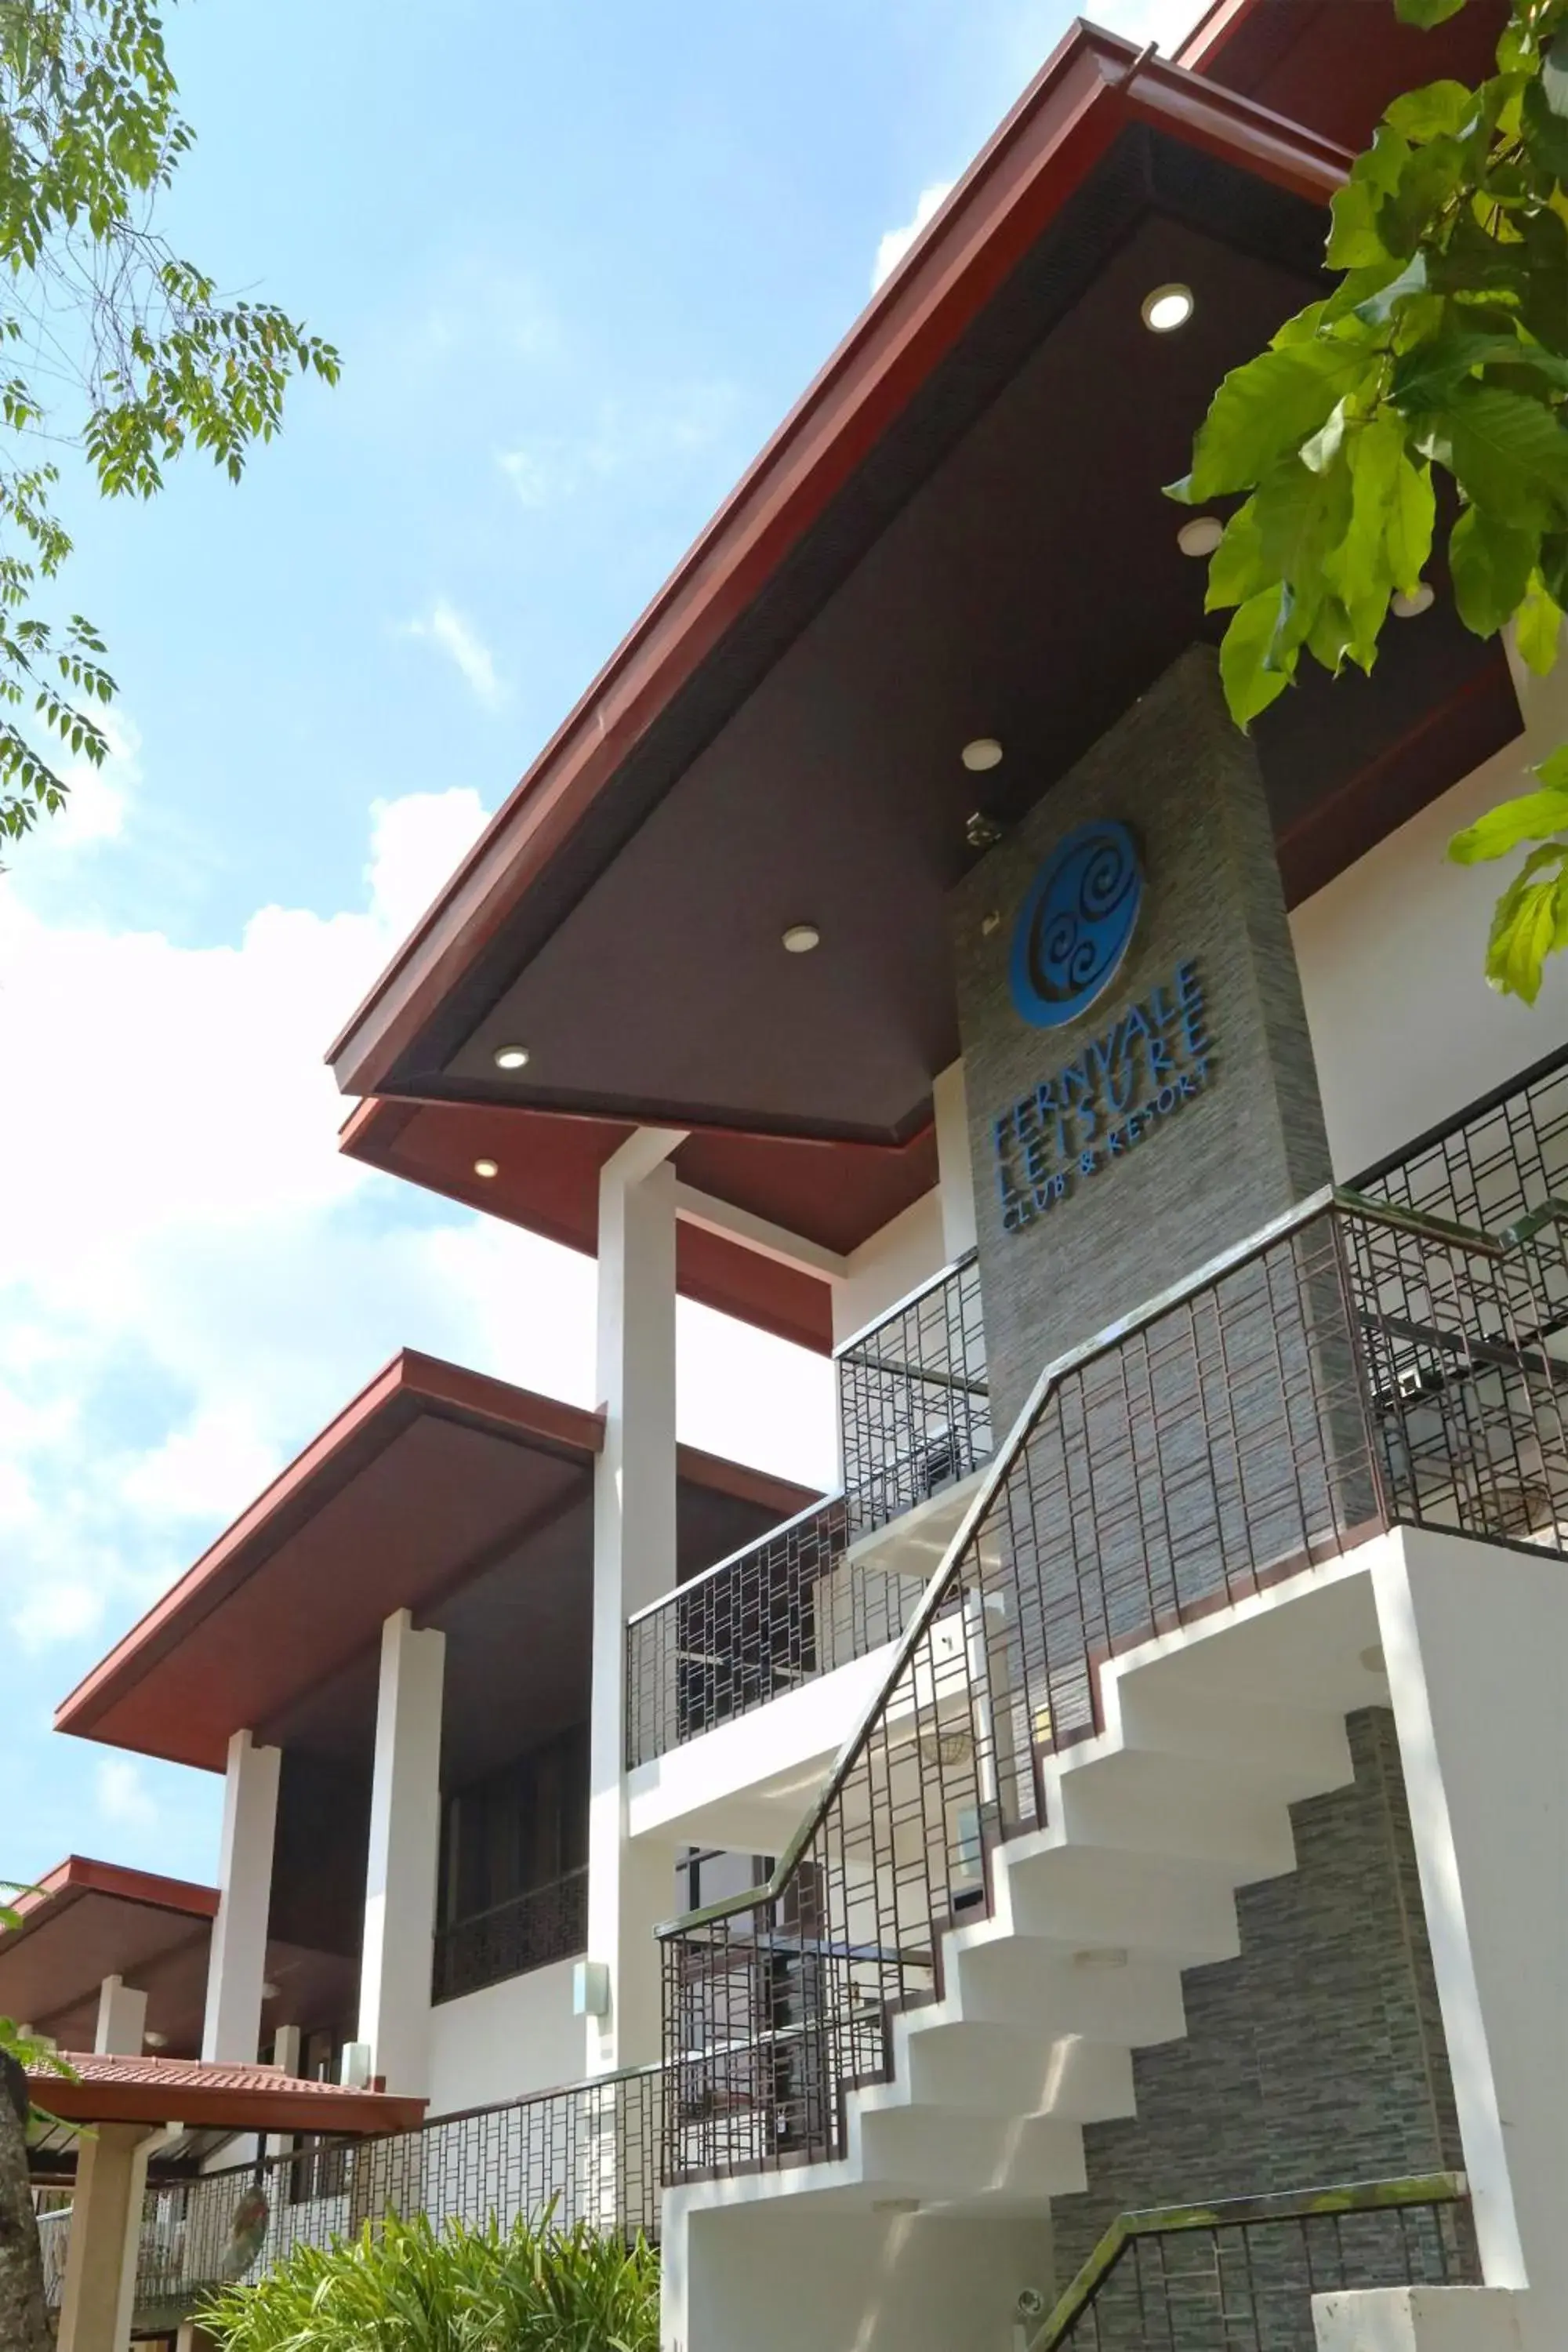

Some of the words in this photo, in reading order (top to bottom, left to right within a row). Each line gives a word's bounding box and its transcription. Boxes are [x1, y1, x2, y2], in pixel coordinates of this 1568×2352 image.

[993, 959, 1202, 1159] FERNVALE
[994, 1000, 1208, 1205] LEISURE
[1003, 1173, 1065, 1231] CLUB
